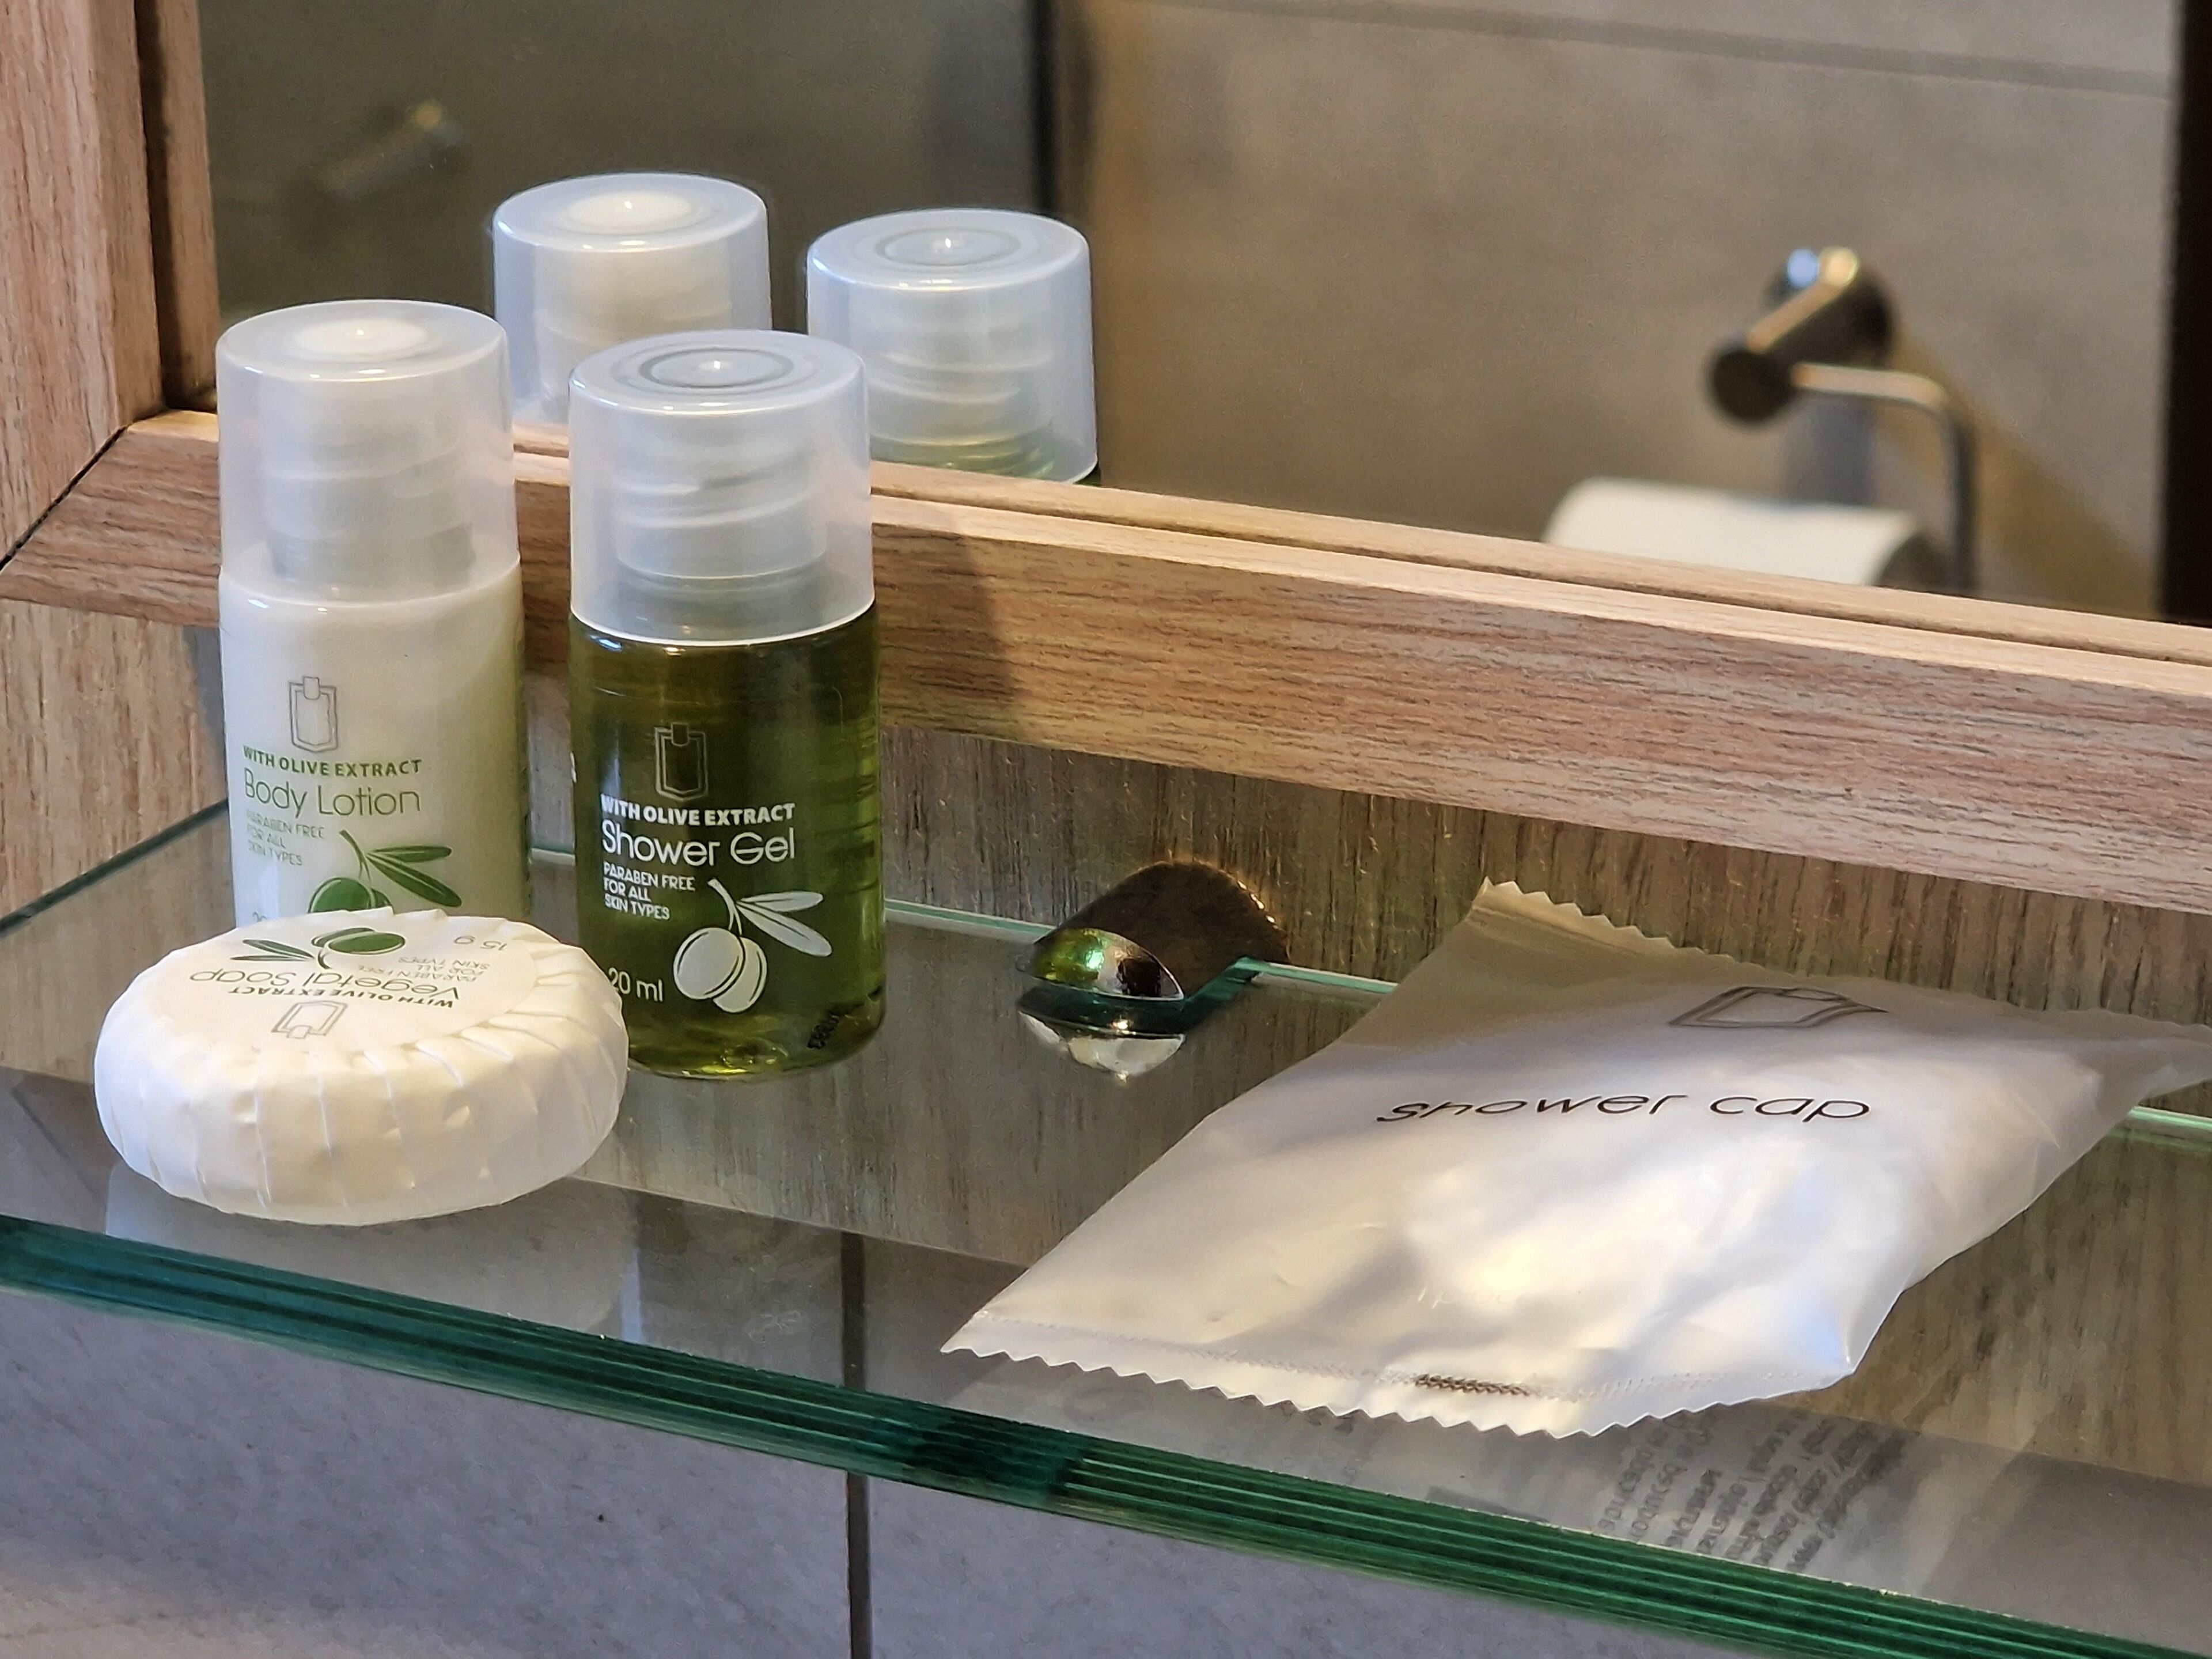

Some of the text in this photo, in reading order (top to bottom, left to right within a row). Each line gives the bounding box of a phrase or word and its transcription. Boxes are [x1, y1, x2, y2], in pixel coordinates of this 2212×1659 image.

[244, 745, 422, 777] WITH OLIVE EXTRACT
[244, 767, 421, 818] Body Lotion
[601, 793, 796, 826] WITH OLIVE EXTRACT
[602, 819, 796, 866] Shower Gel
[603, 860, 695, 891] PARABEN FREE
[603, 877, 652, 903] FOR ALL
[604, 893, 671, 921] SKIN TYPES
[480, 940, 508, 951] 15
[190, 968, 459, 999] Vegetal Soap
[228, 987, 454, 1009] WITH OLIVE EXTRACT
[608, 967, 664, 1003] 20 ml
[1376, 1093, 1870, 1123] shower cap
